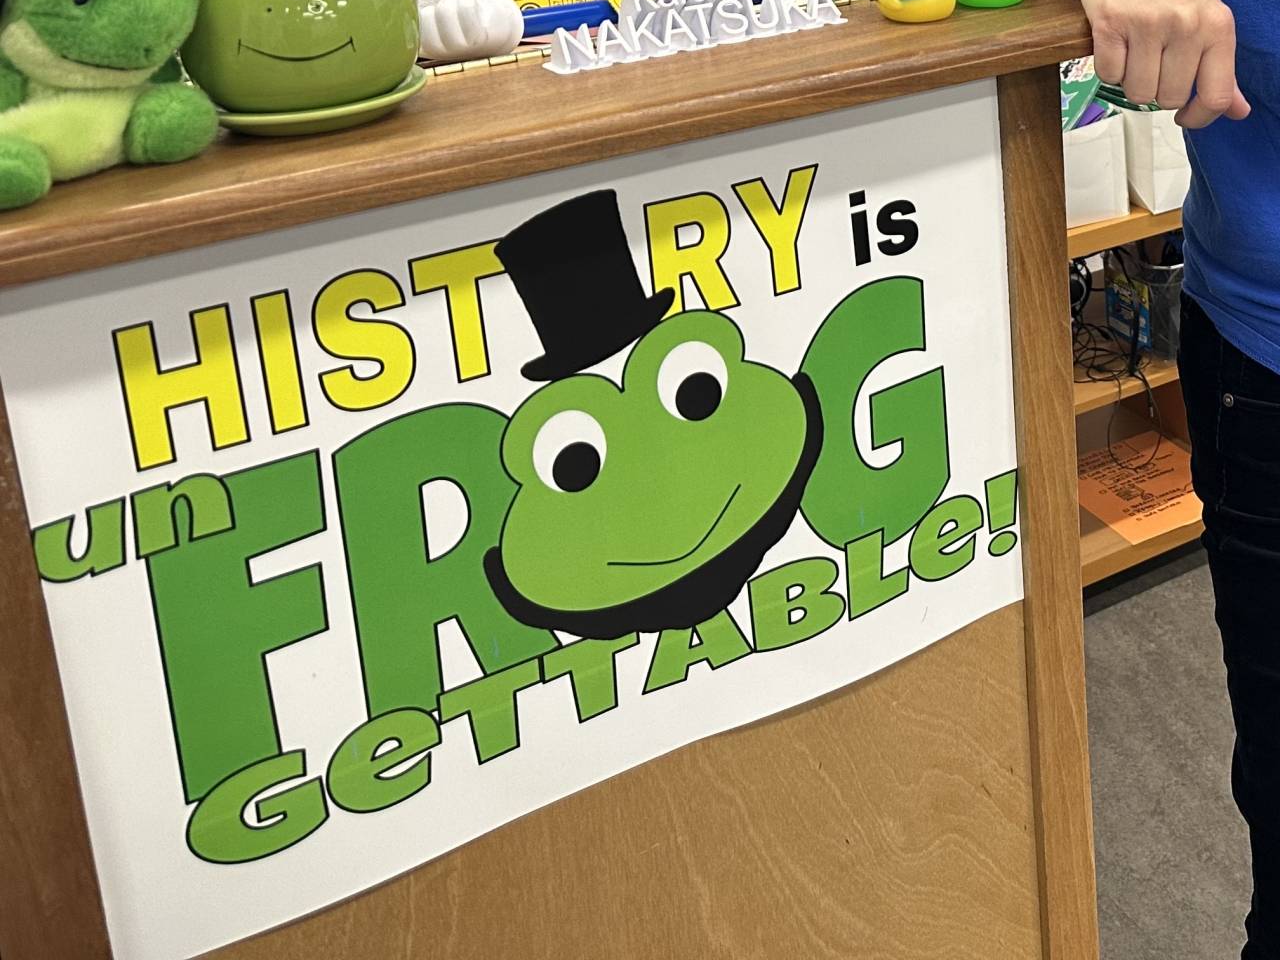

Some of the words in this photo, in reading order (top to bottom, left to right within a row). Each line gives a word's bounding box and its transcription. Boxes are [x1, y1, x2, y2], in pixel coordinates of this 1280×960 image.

[112, 163, 819, 472] HISTRY
[849, 189, 921, 267] is
[31, 469, 234, 585] un
[141, 275, 953, 808] FRG
